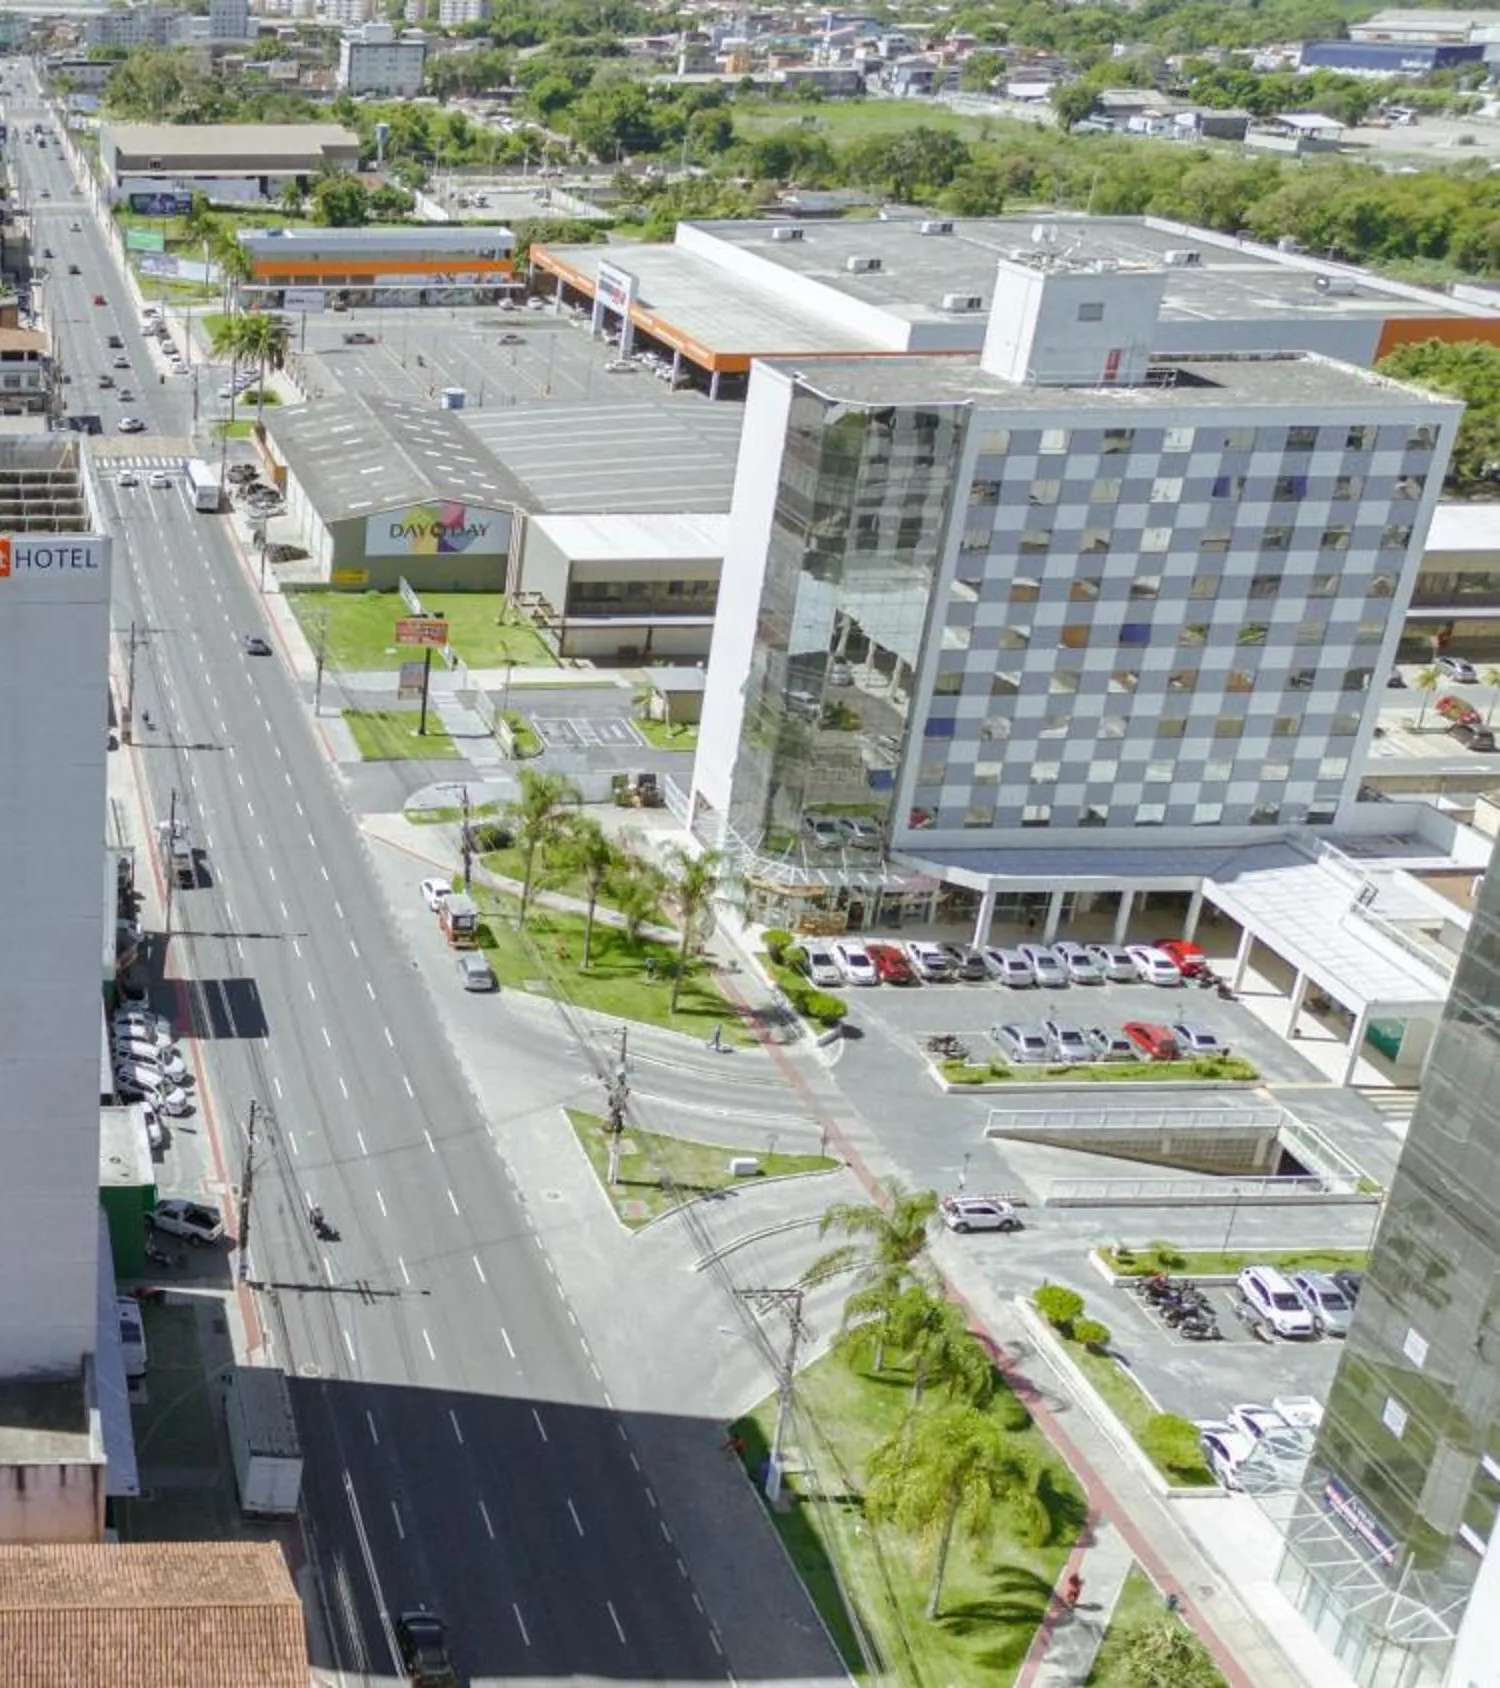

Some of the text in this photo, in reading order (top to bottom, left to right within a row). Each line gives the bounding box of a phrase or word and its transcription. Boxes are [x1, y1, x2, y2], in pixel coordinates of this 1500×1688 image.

[389, 523, 429, 538] DAY
[450, 522, 491, 537] DAY
[15, 548, 98, 569] HOTEL
